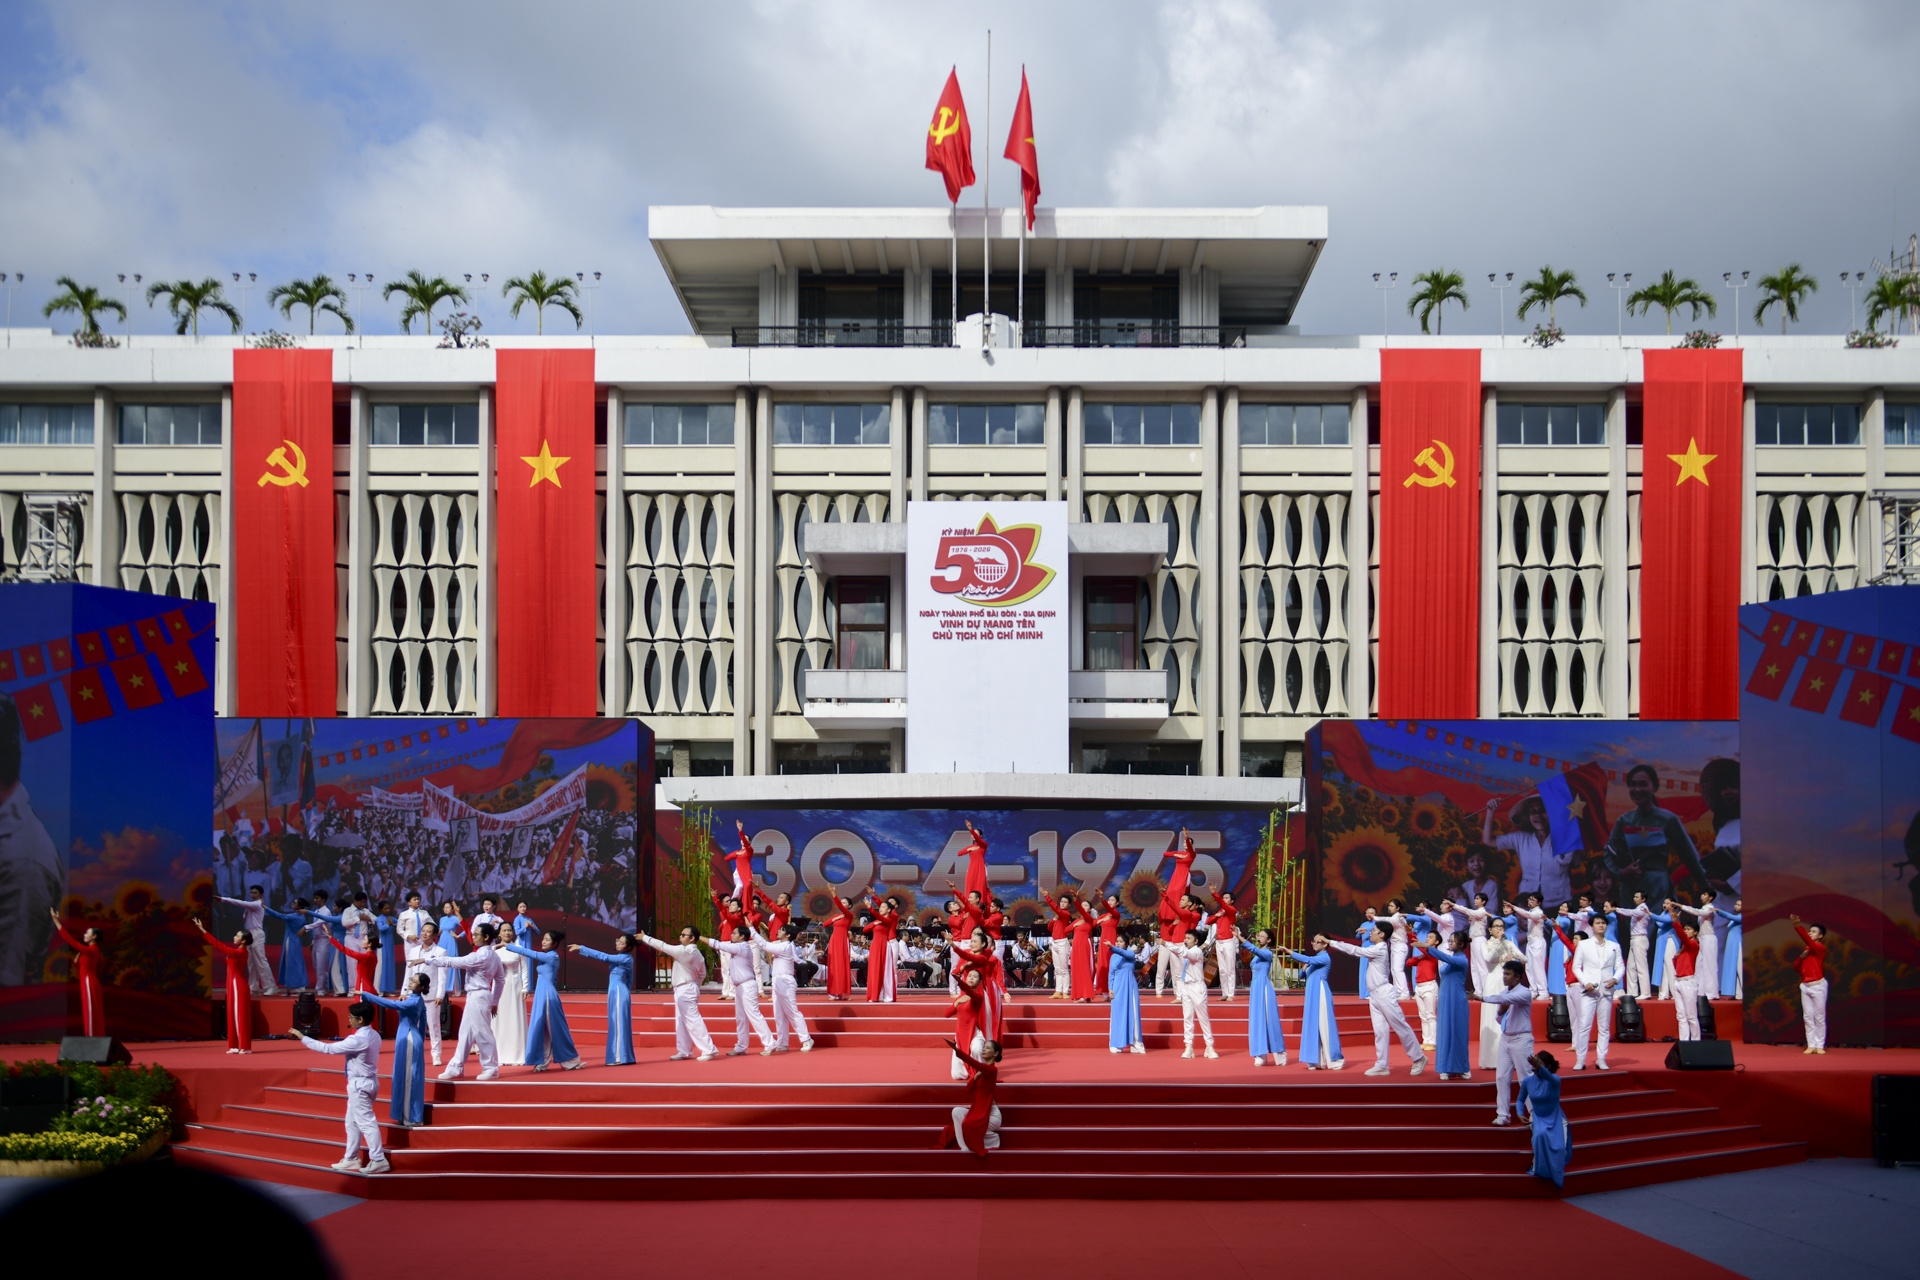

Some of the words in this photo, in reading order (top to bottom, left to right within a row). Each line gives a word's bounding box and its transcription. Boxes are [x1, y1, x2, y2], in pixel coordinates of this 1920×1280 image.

[954, 528, 975, 538] NIỆM
[930, 536, 1019, 594] 50
[962, 583, 1006, 596] năm
[919, 609, 940, 617] NGÀY
[941, 609, 967, 617] THÀNH
[969, 608, 985, 617] PHỐ
[986, 609, 999, 617] SÀI
[1000, 609, 1017, 617] GÒN
[1037, 610, 1056, 618] ĐỊNH
[940, 619, 964, 628] VINH
[966, 619, 981, 629] DỰ
[983, 619, 1014, 628] MANG
[1016, 618, 1036, 628] TÊN
[932, 629, 953, 640] CHỦ
[955, 631, 977, 641] TỊCH
[980, 629, 994, 640] HỒ
[996, 630, 1014, 640] CHÍ
[1016, 631, 1043, 640] MINH
